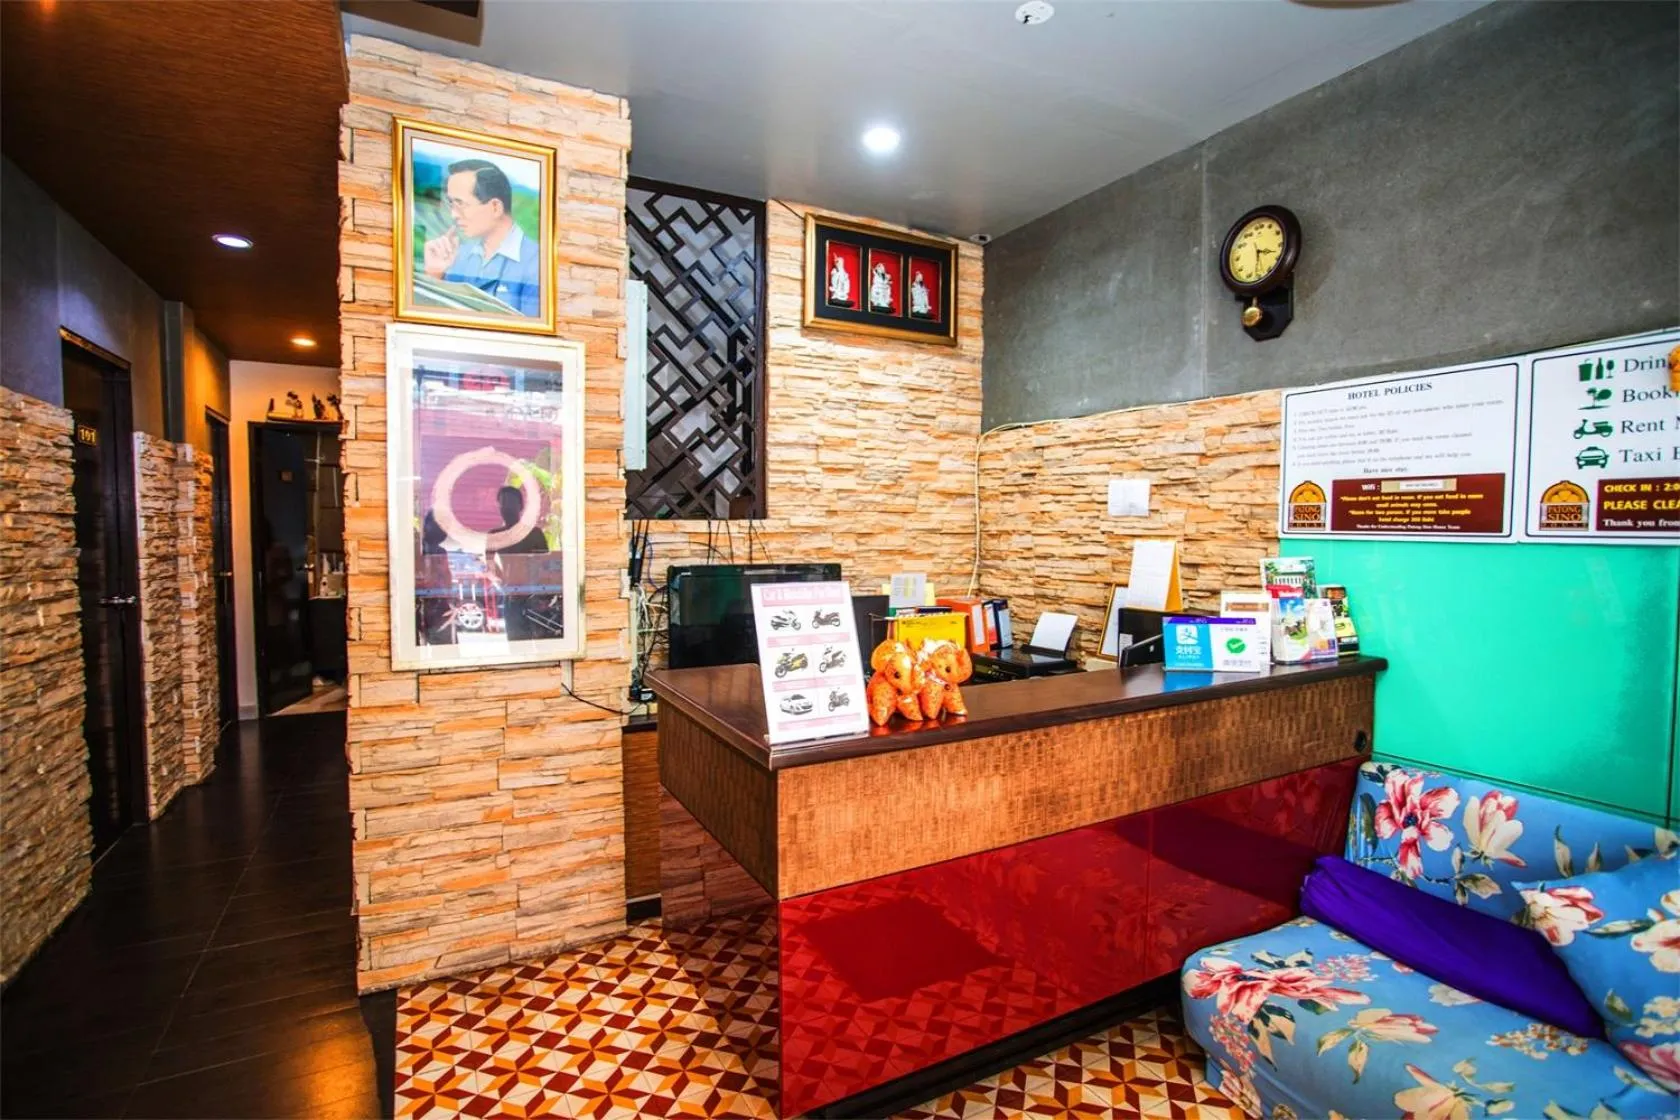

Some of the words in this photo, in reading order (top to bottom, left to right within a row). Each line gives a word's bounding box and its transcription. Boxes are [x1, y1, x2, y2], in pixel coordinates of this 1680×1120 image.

[1623, 355, 1667, 373] Drin
[1347, 389, 1380, 400] HOTEL
[1384, 382, 1433, 396] POLICIES
[1621, 419, 1665, 434] Rent
[1618, 447, 1662, 463] Taxi
[1604, 484, 1637, 493] CHECK
[1640, 483, 1652, 492] IN
[1604, 500, 1648, 510] PLEASE
[1294, 513, 1320, 521] SINO
[1451, 508, 1472, 516] people
[1547, 513, 1581, 521] SINO
[1603, 518, 1634, 527] Thank
[1636, 520, 1656, 529] you
